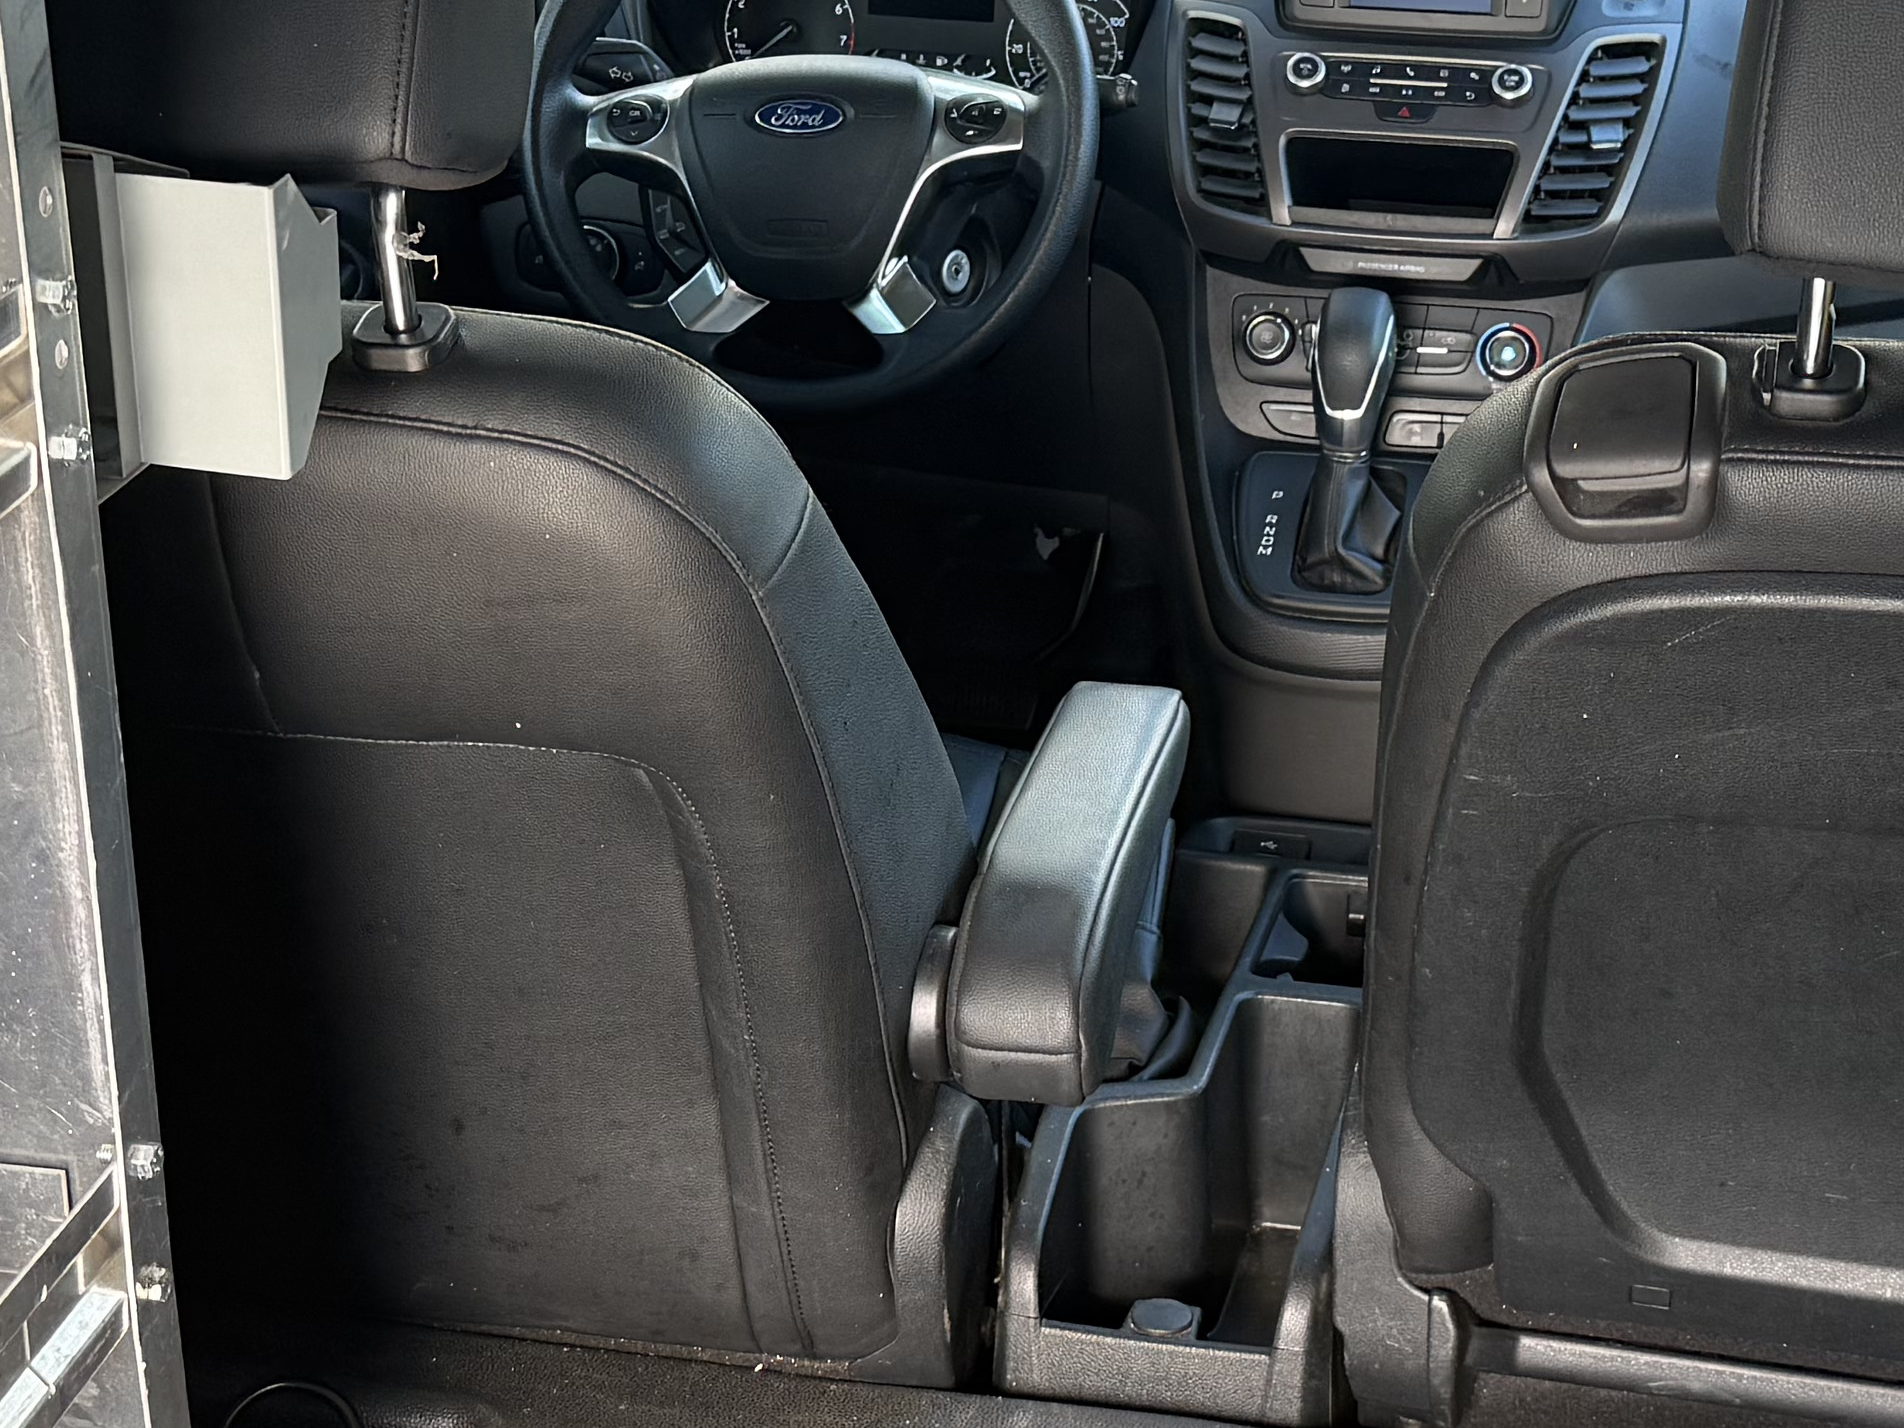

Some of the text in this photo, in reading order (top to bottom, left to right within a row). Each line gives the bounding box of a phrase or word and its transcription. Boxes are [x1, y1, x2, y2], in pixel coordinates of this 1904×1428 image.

[835, 3, 843, 15] 6
[732, 28, 738, 39] 1
[840, 35, 847, 47] 7
[771, 103, 825, 126] Ford
[1272, 490, 1284, 500] P
[1265, 514, 1278, 524] R
[1263, 526, 1276, 535] N
[1261, 536, 1274, 545] D
[1257, 546, 1272, 556] M
